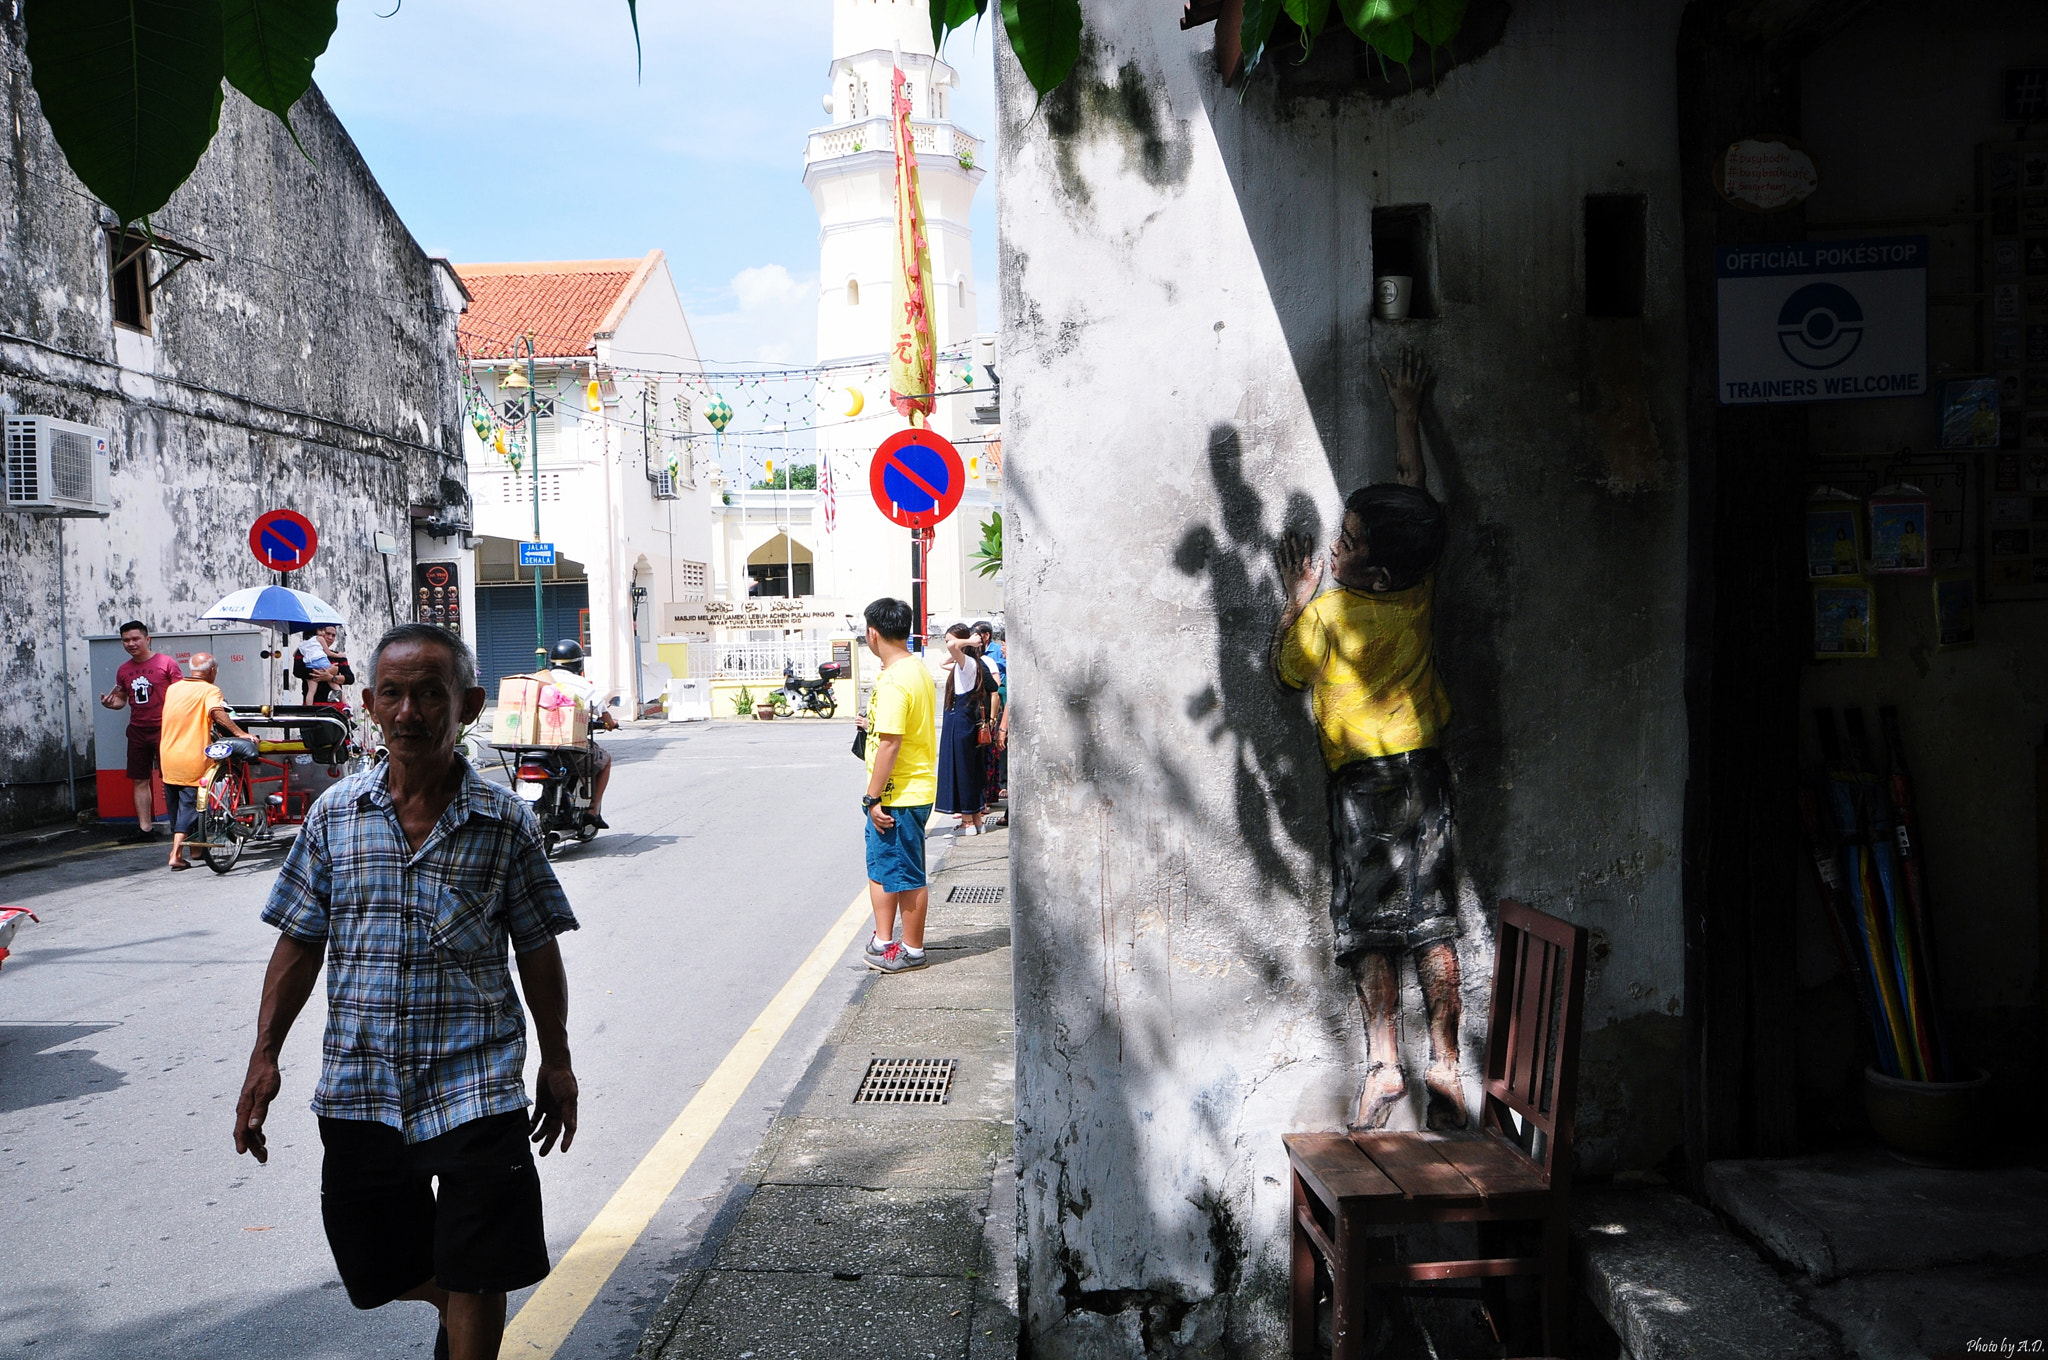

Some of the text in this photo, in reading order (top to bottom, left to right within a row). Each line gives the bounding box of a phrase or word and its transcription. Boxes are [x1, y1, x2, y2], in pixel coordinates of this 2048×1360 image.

[1726, 243, 1918, 270] OFFICIAL POKÉSTOP
[1726, 373, 1920, 399] TRAINERS WELCOME
